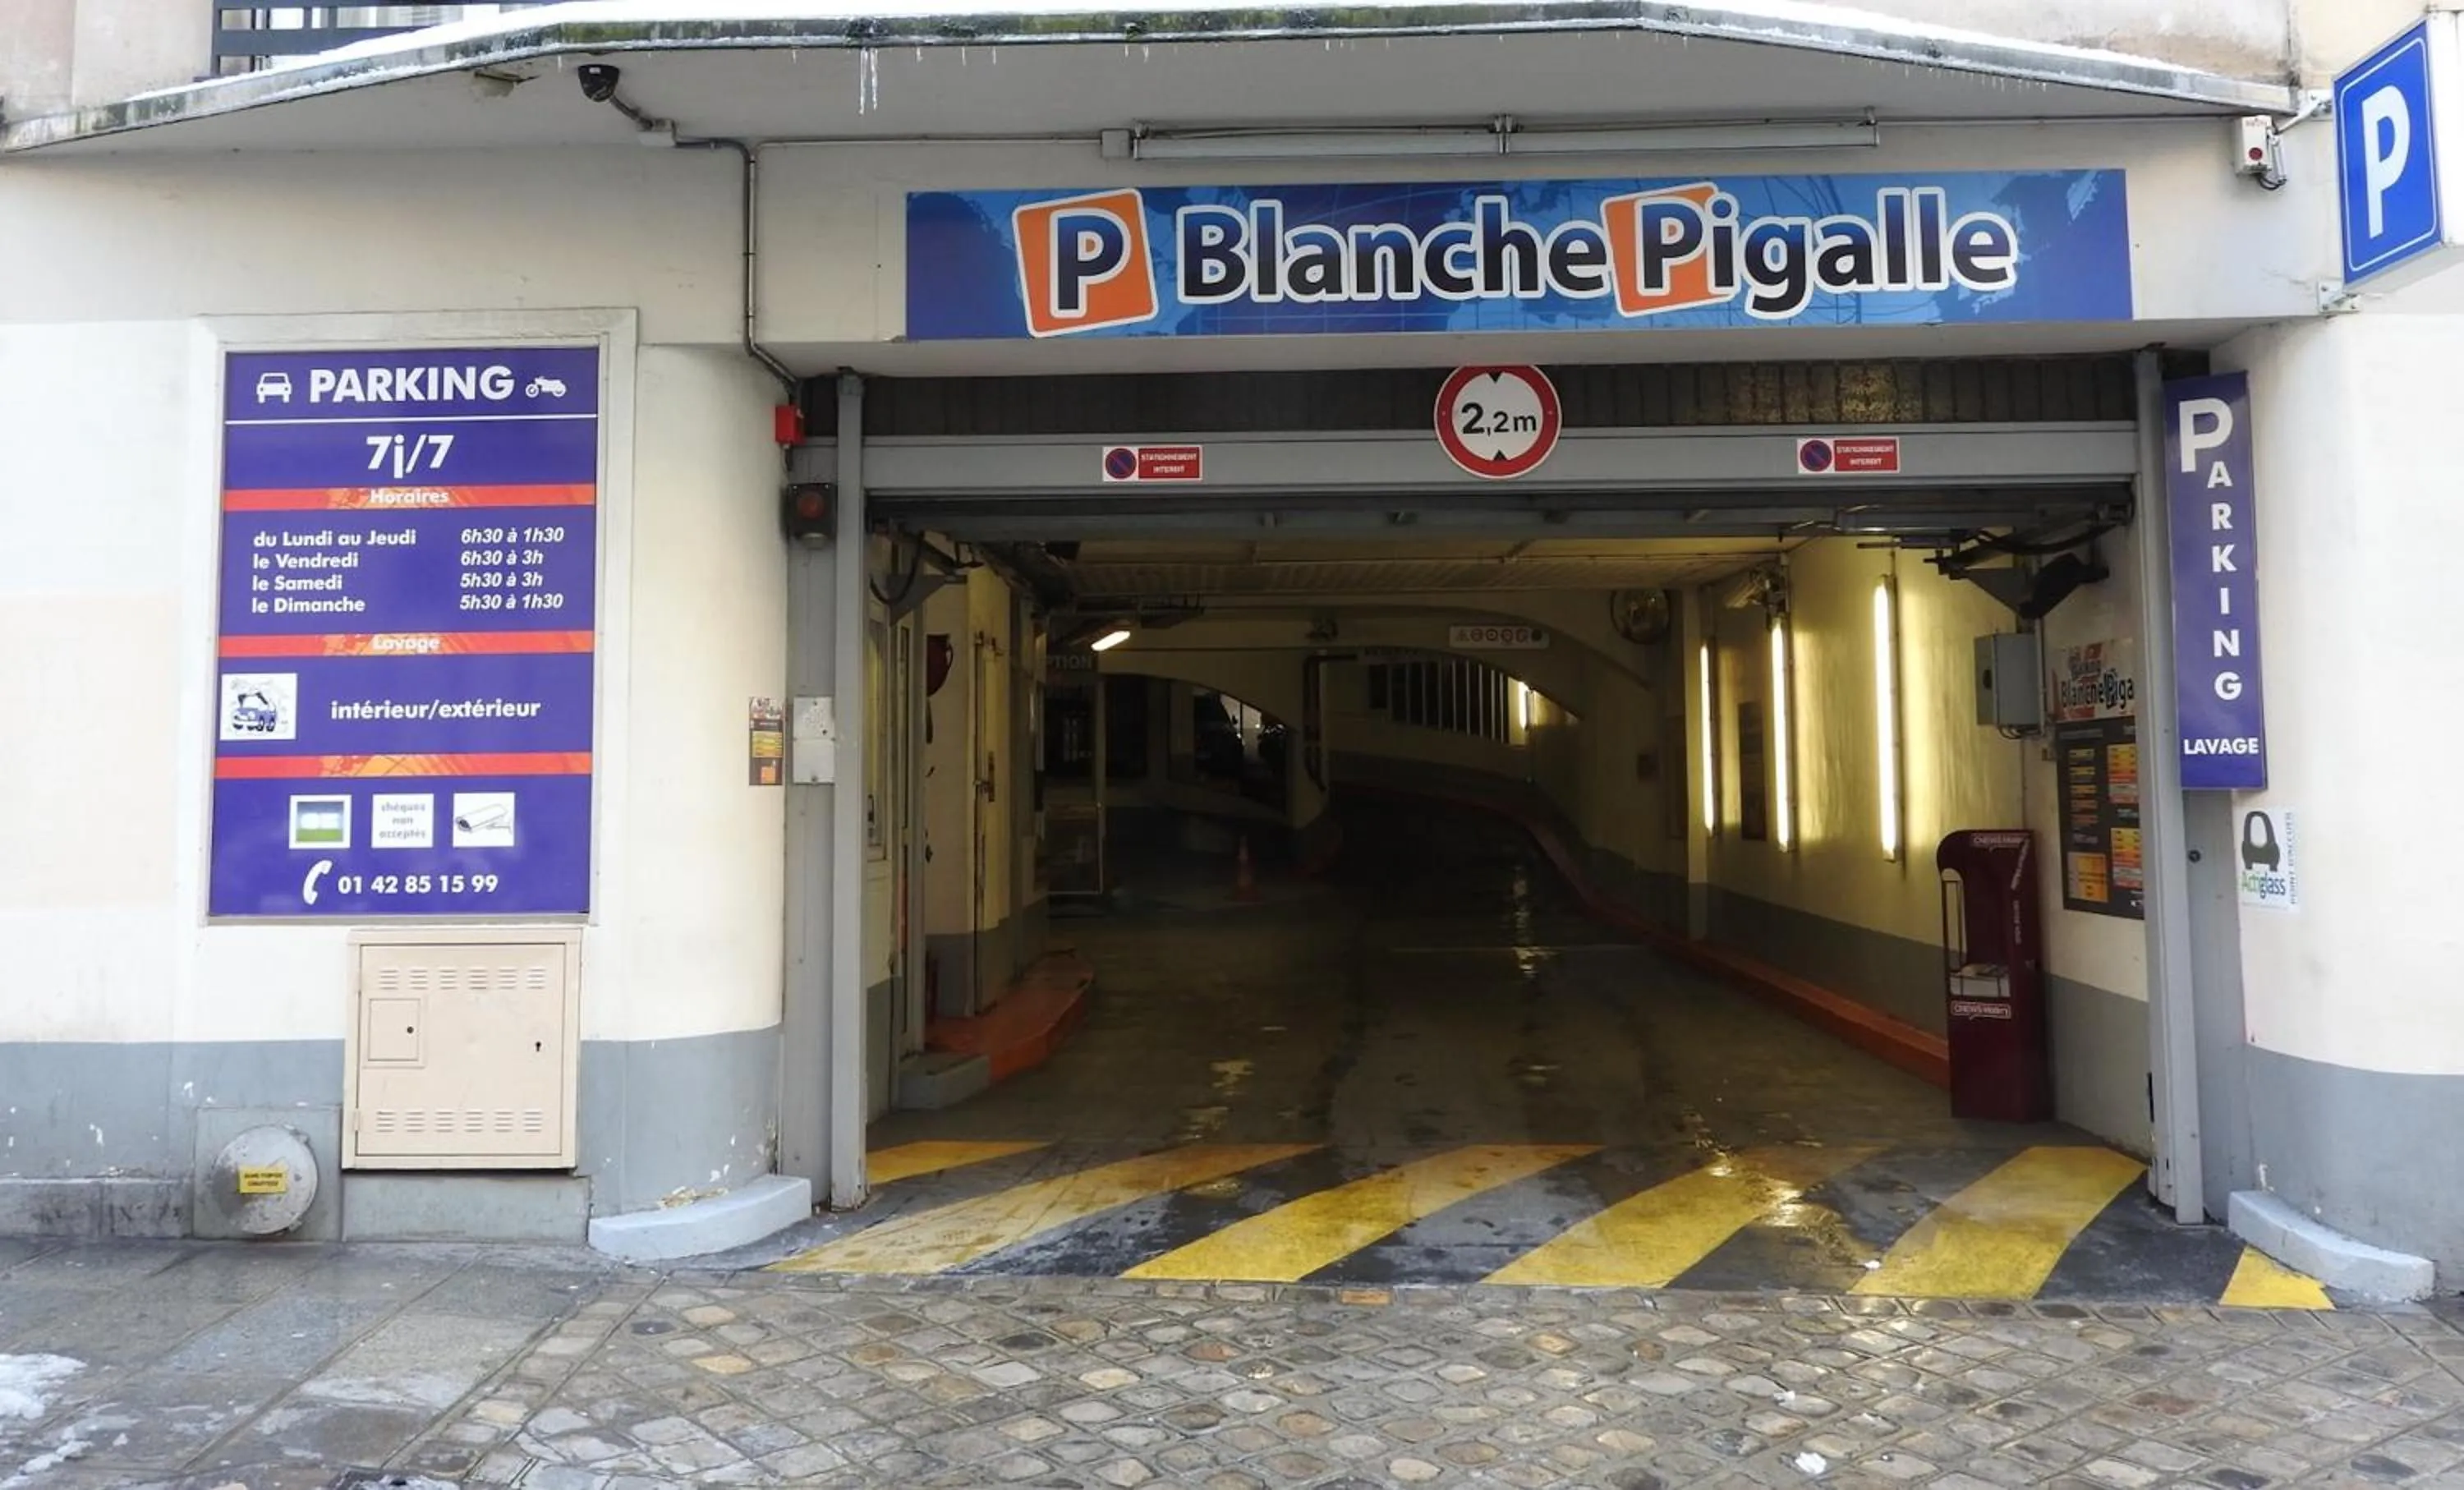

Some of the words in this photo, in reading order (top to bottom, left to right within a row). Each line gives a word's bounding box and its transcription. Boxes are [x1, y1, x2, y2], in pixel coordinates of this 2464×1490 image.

[2362, 85, 2411, 239] P
[1050, 208, 1132, 318] P
[1176, 195, 1610, 304] Blanche
[1636, 186, 2017, 318] Pigalle
[310, 366, 515, 403] PARKING
[365, 434, 454, 479] 7j/7
[370, 489, 448, 504] Horaires
[253, 531, 277, 548] du
[282, 530, 333, 547] Lundi
[338, 534, 361, 546] au
[365, 528, 416, 546] Jeudi
[461, 527, 503, 544] 6h30
[506, 527, 518, 543] à
[523, 527, 564, 543] 1h30
[253, 553, 270, 570] le
[274, 551, 359, 569] Vendredi
[461, 550, 503, 566] 6h30
[506, 550, 517, 565] à
[522, 549, 544, 565] 3h
[251, 574, 269, 592] le
[274, 573, 342, 591] Samedi
[460, 572, 503, 588] 5h30
[505, 572, 517, 587] à
[522, 571, 544, 587] 3h
[251, 596, 269, 614] le
[274, 596, 365, 614] Dimanche
[460, 594, 503, 610] 5h30
[505, 594, 517, 609] à
[522, 593, 564, 609] 1h30
[372, 636, 441, 654] Lavage
[331, 697, 541, 720] intérieur/extérieur
[2184, 737, 2259, 755] LAVAGE
[338, 876, 362, 894] 01
[370, 875, 398, 894] 42
[404, 875, 432, 894] 85
[439, 875, 465, 893] 15
[471, 874, 499, 893] 99
